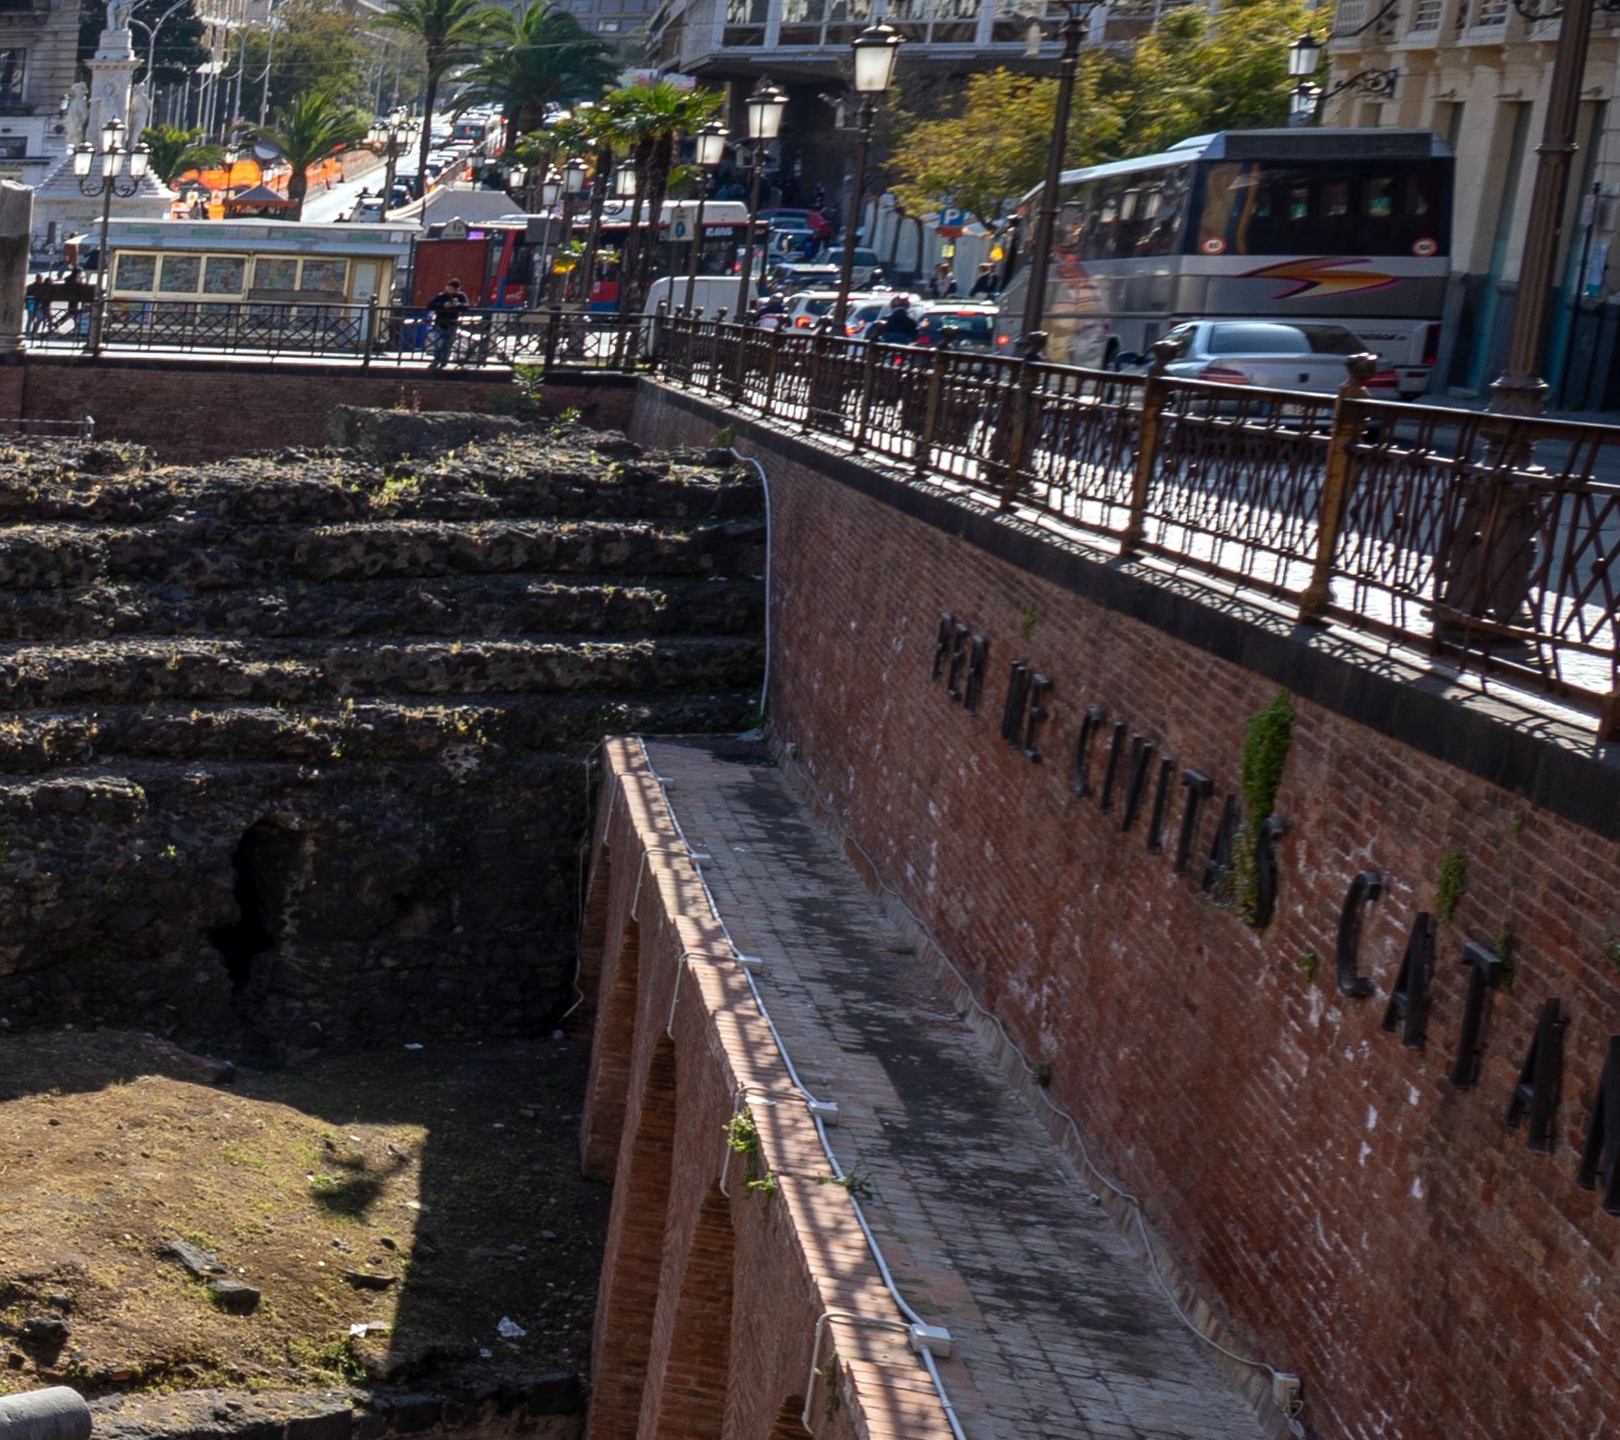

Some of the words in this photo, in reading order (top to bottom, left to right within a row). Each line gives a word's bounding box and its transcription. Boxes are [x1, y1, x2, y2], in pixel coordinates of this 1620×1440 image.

[944, 209, 960, 224] P
[932, 613, 988, 718] PER
[1002, 661, 1053, 764] ME
